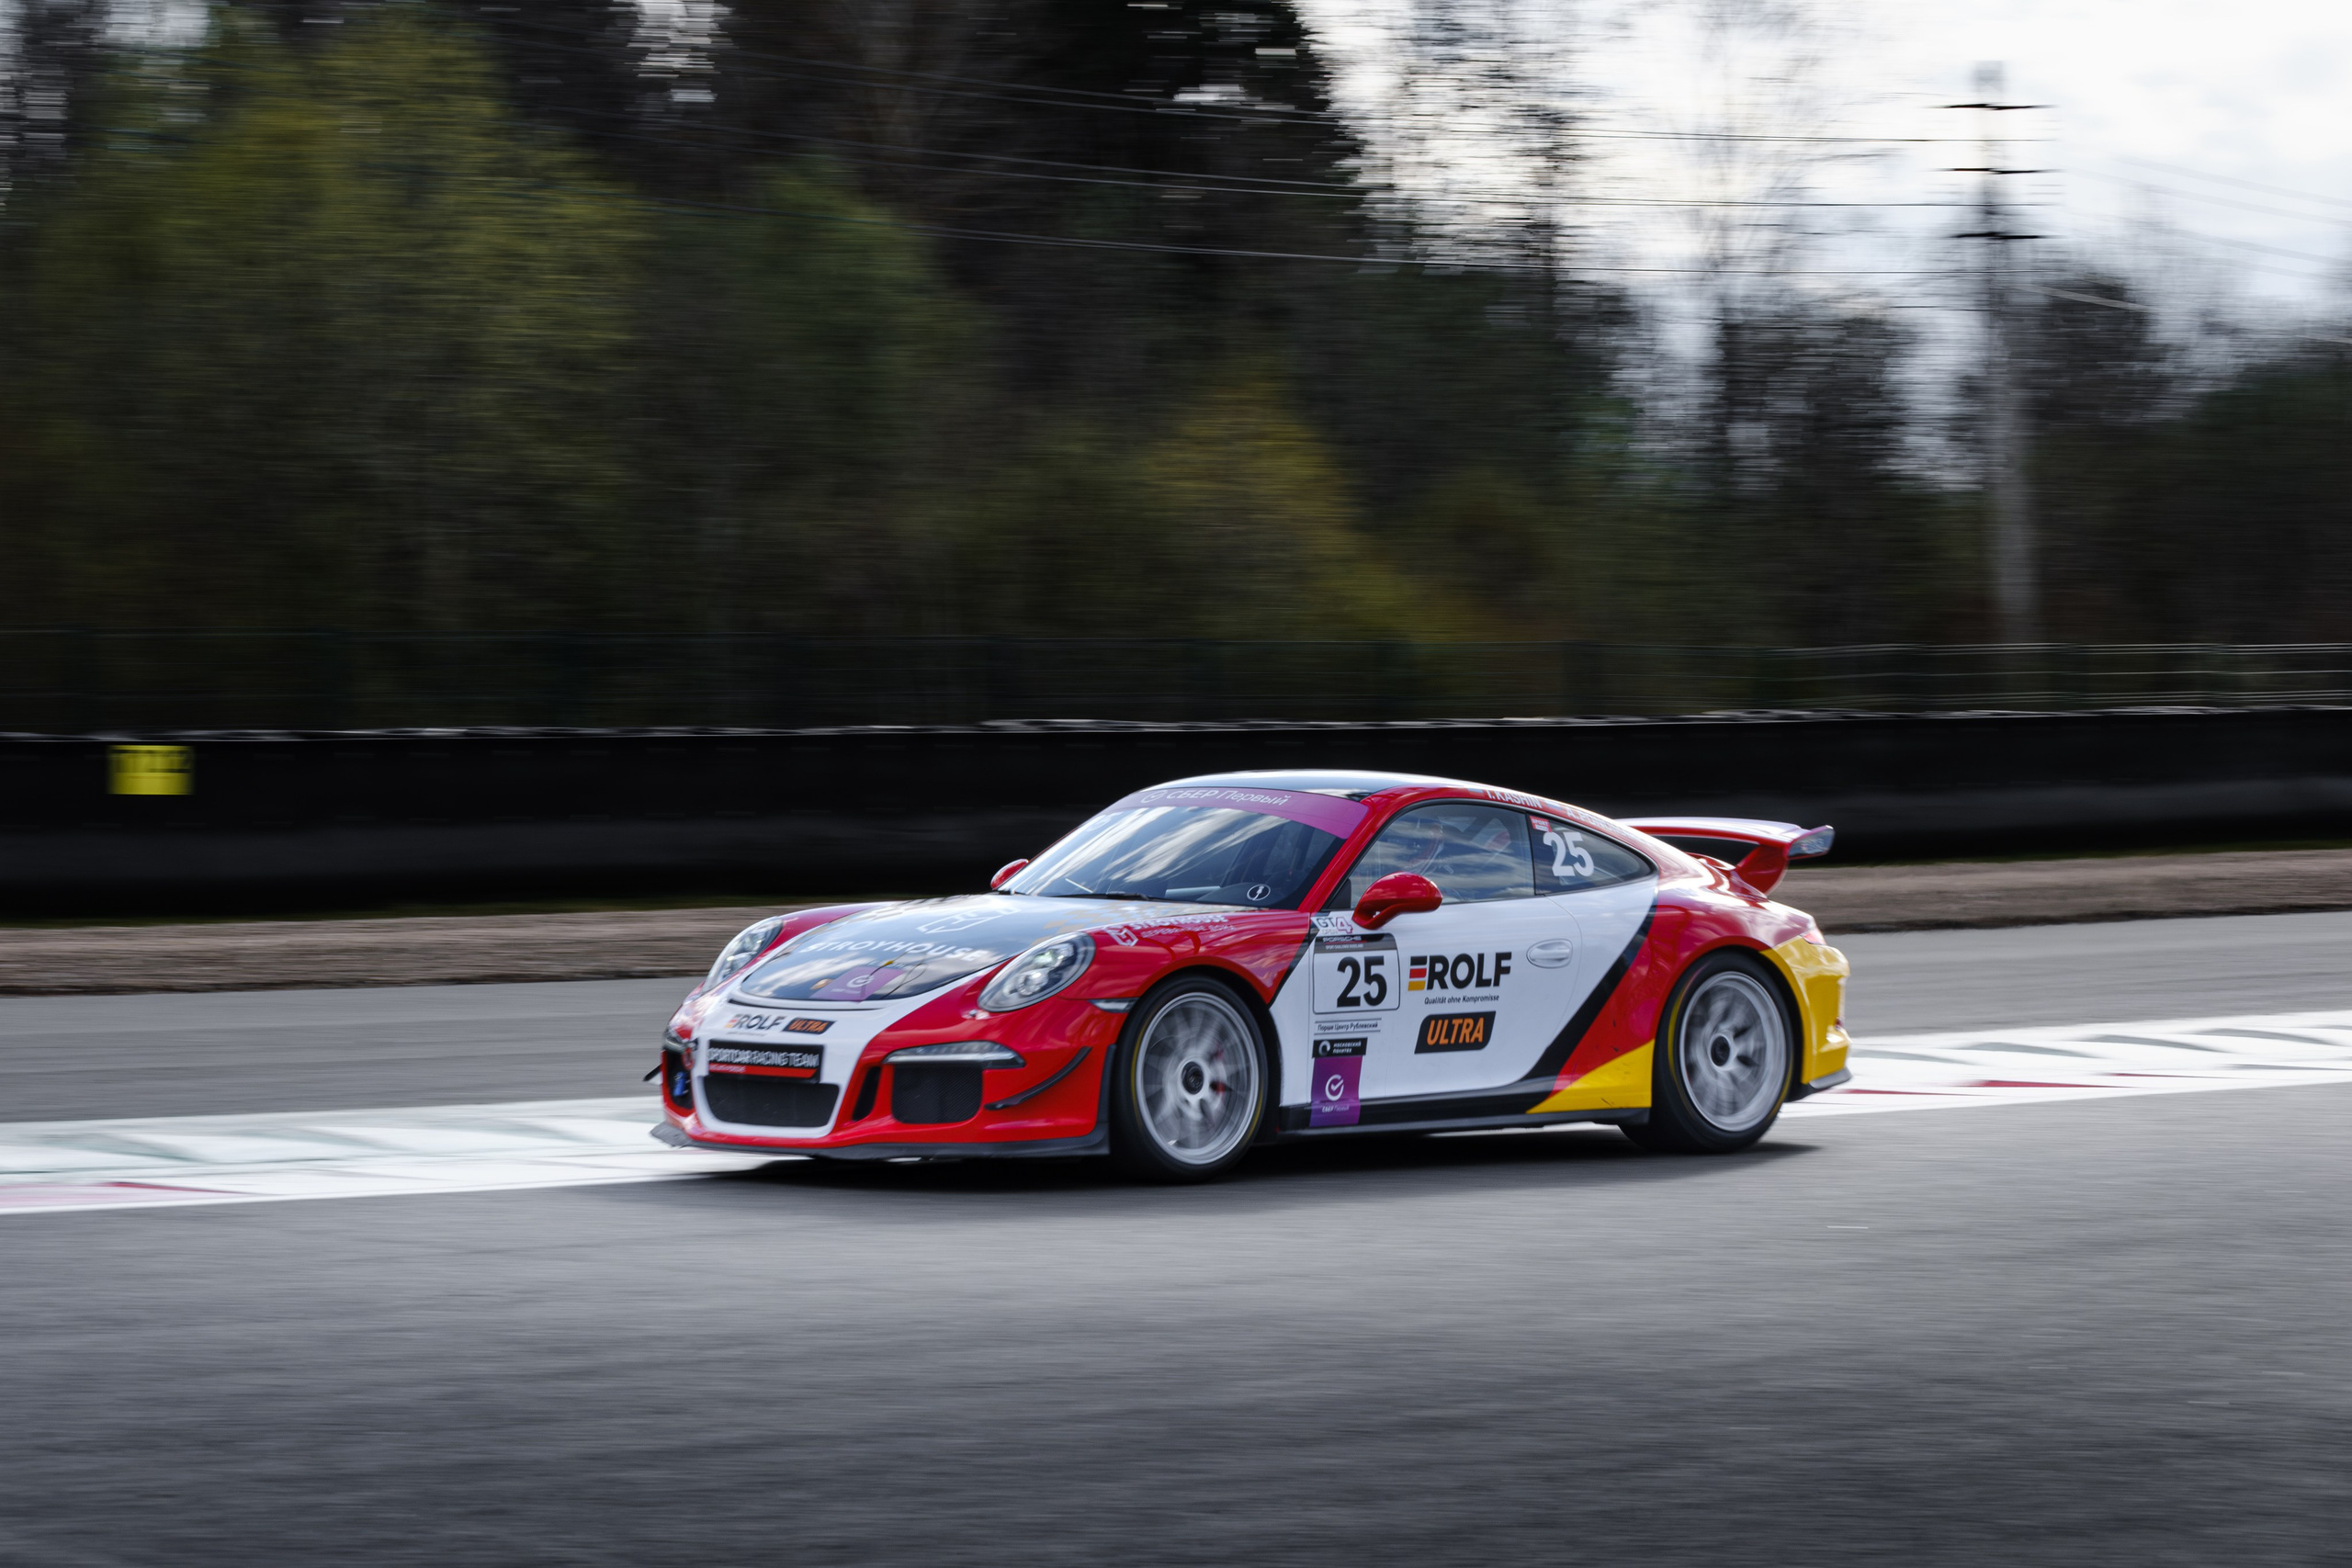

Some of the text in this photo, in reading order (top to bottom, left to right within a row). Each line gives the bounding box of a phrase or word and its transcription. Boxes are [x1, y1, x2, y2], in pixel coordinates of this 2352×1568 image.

[1166, 789, 1292, 806] СБЕР Первый
[1543, 831, 1595, 876] 25
[798, 940, 989, 962] STROYHOUSE
[1427, 952, 1512, 990] ROLF
[1337, 955, 1387, 1008] 25
[1424, 994, 1499, 1005] Qualität ohne Kompromisse
[733, 1014, 786, 1030] ROLF
[787, 1018, 829, 1032] ULTRA
[1334, 1023, 1350, 1032] Центр
[1427, 1017, 1485, 1045] ULTRA
